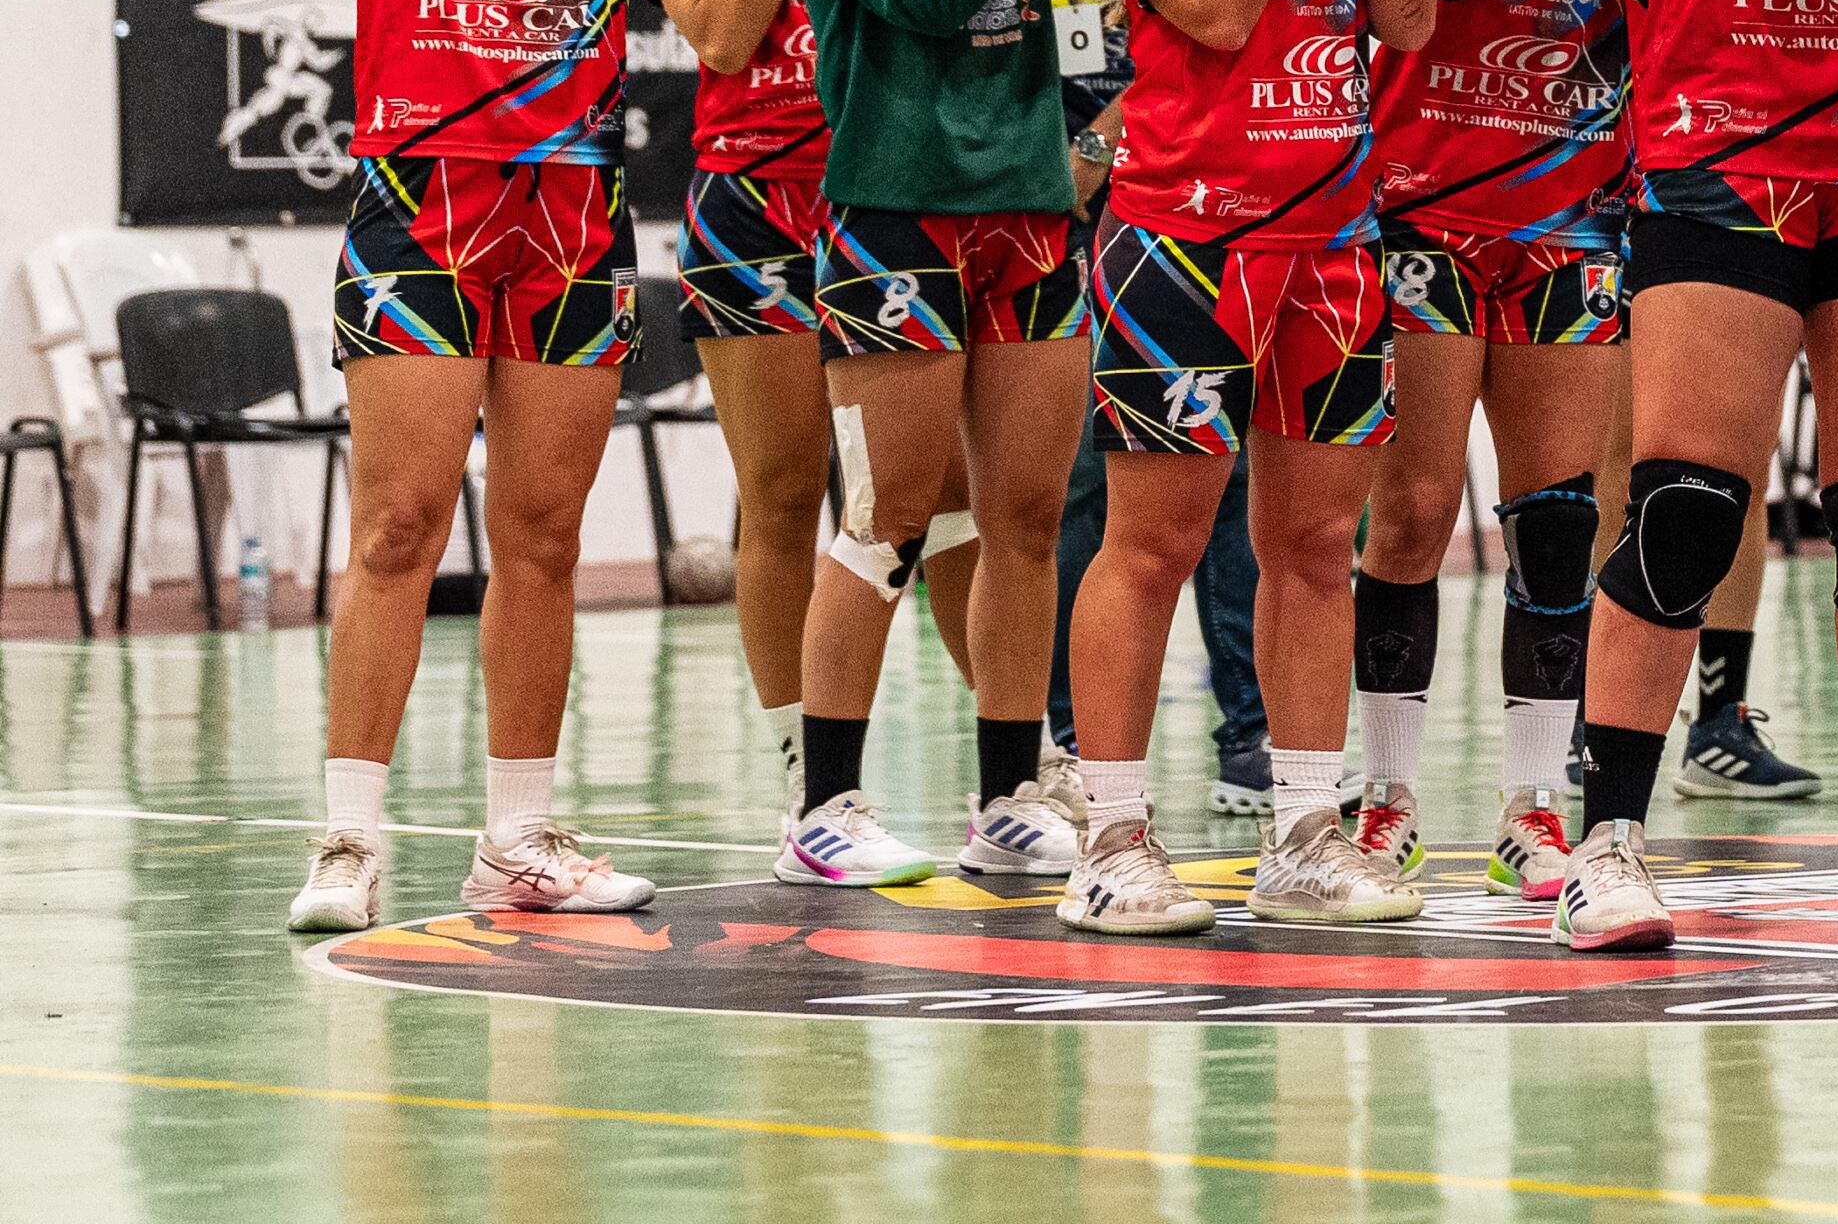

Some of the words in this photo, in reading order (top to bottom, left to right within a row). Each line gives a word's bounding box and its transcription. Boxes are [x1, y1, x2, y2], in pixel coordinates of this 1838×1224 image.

[750, 60, 817, 88] PLU
[1251, 80, 1332, 108] PLUS
[1428, 65, 1530, 100] PLUS
[1544, 80, 1615, 110] CAR
[1293, 108, 1327, 117] RENT
[1420, 107, 1615, 142] www.autospluscar.com
[1474, 95, 1523, 110] RENT
[1543, 105, 1571, 117] CAR
[363, 275, 403, 333] 7
[750, 261, 789, 310] 5
[878, 271, 921, 329] 8
[1163, 369, 1237, 428] 15
